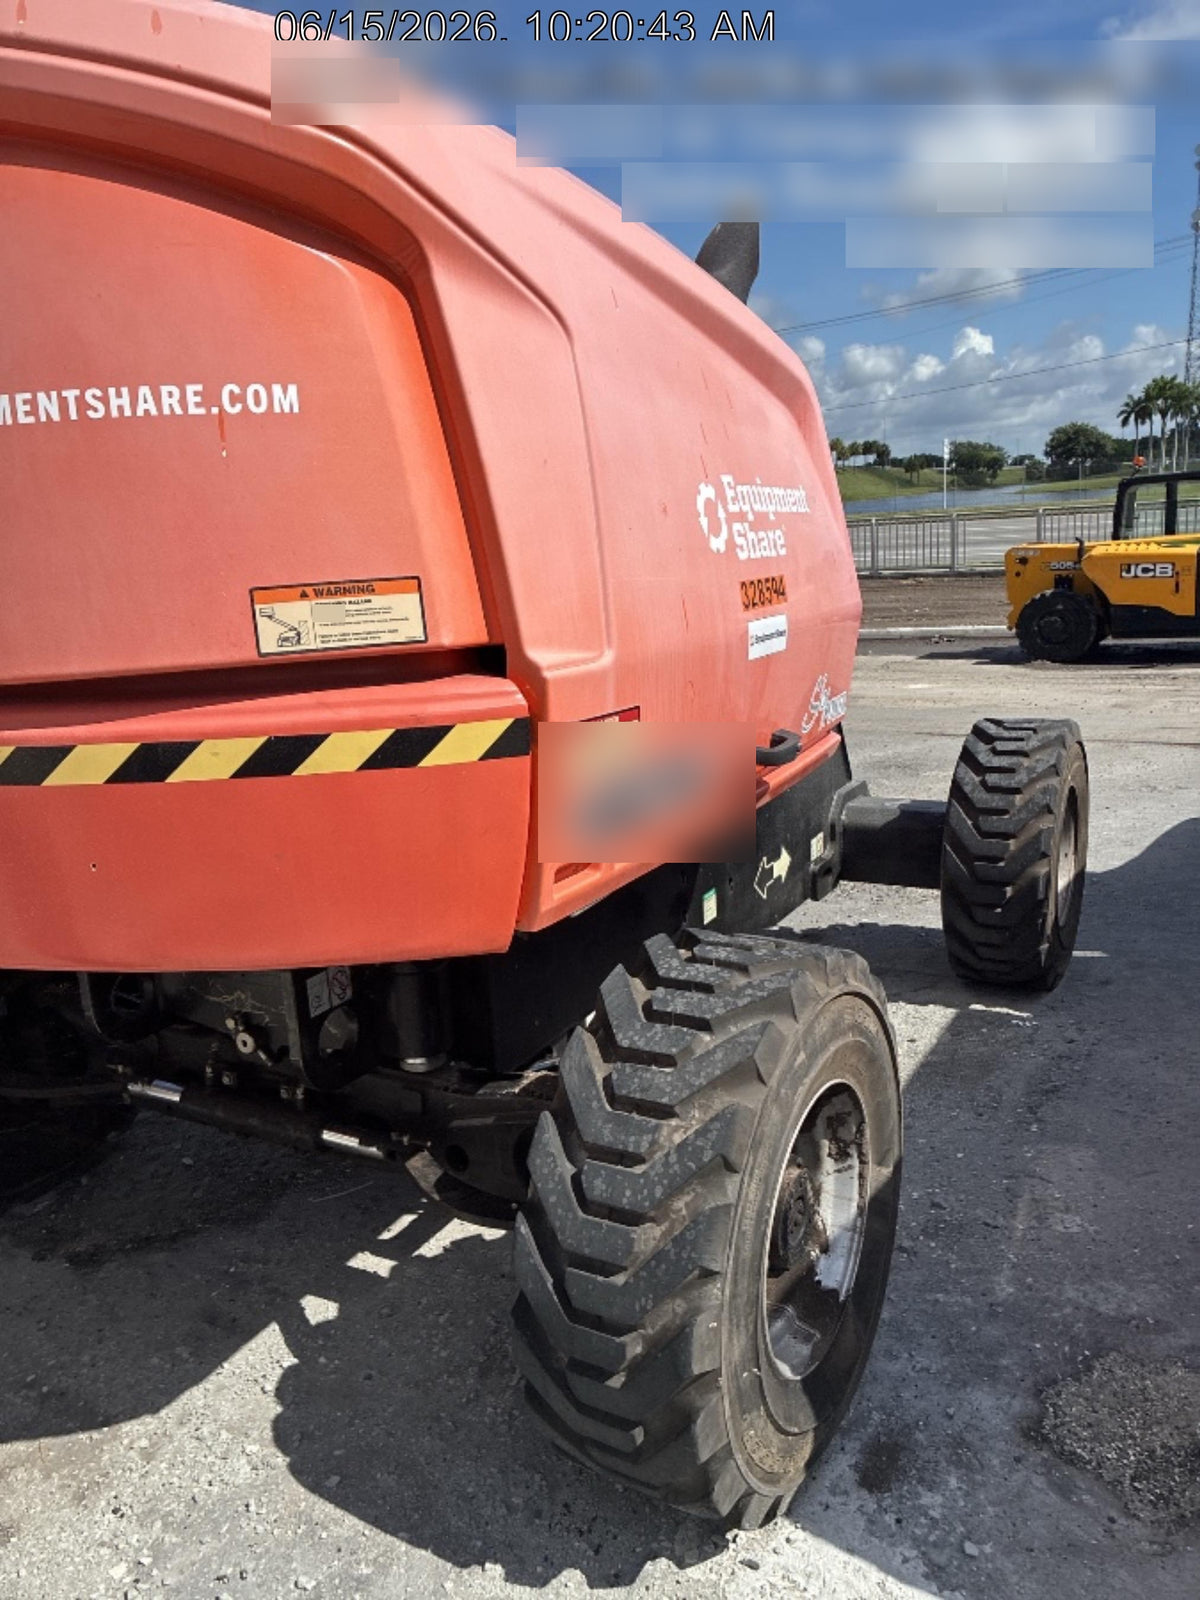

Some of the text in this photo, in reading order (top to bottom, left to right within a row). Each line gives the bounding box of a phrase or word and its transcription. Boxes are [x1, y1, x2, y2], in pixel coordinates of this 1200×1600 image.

[720, 474, 810, 521] Equipment
[732, 522, 787, 560] Share
[1121, 563, 1174, 578] JCB
[313, 584, 375, 598] WARNING
[740, 576, 786, 609] 328594
